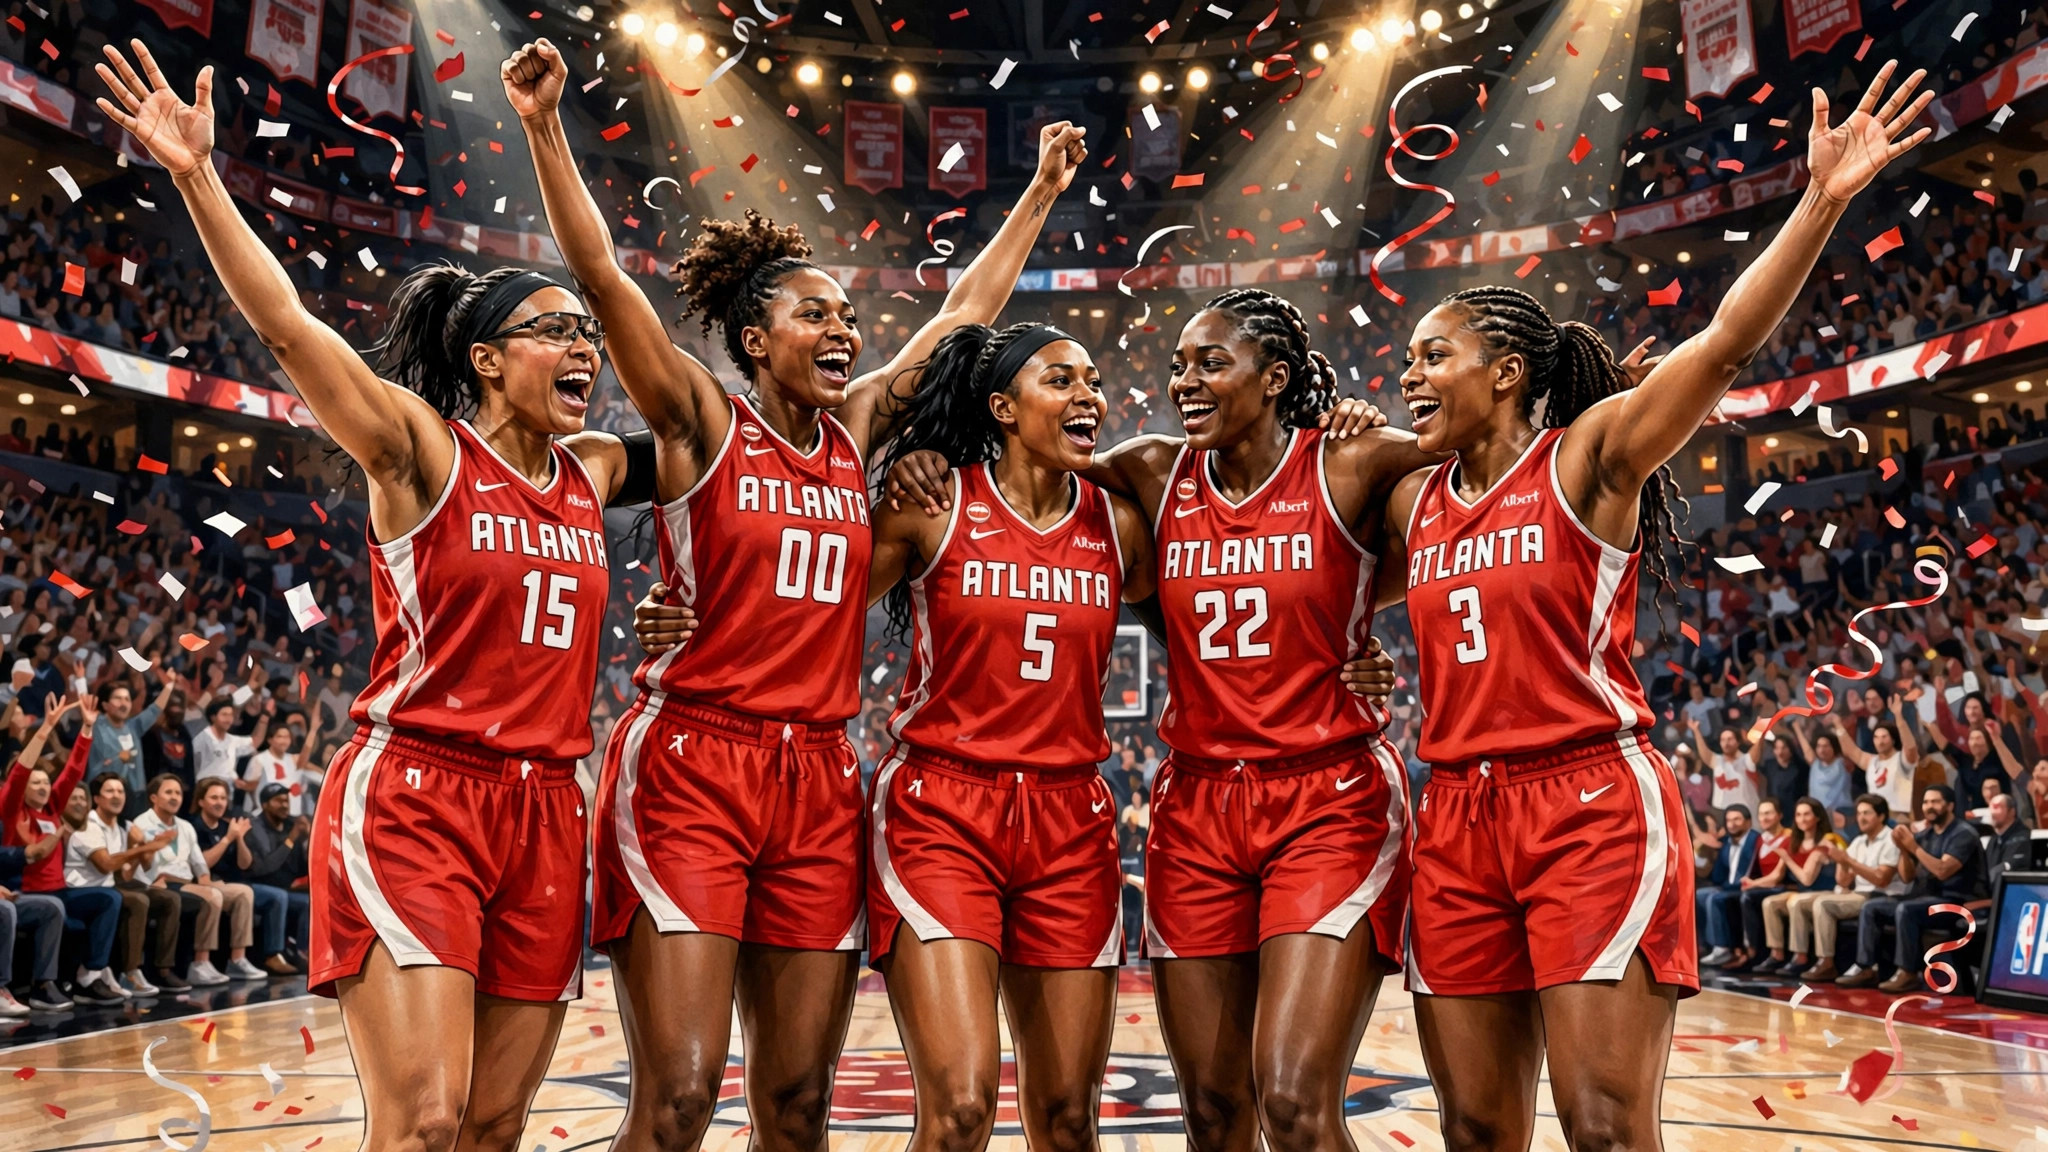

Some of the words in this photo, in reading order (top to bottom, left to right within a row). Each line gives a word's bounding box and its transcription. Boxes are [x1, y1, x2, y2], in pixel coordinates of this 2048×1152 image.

[737, 474, 869, 528] ATLANTA
[471, 511, 609, 570] ATLANTA
[774, 527, 848, 605] 00
[1164, 532, 1313, 580] ATLANTA
[1408, 523, 1544, 590] ATLANTA
[520, 569, 579, 650] 15
[961, 559, 1110, 610] ATLANTA
[1019, 611, 1058, 682] 5
[1194, 586, 1271, 661] 22
[1448, 585, 1488, 665] 3
